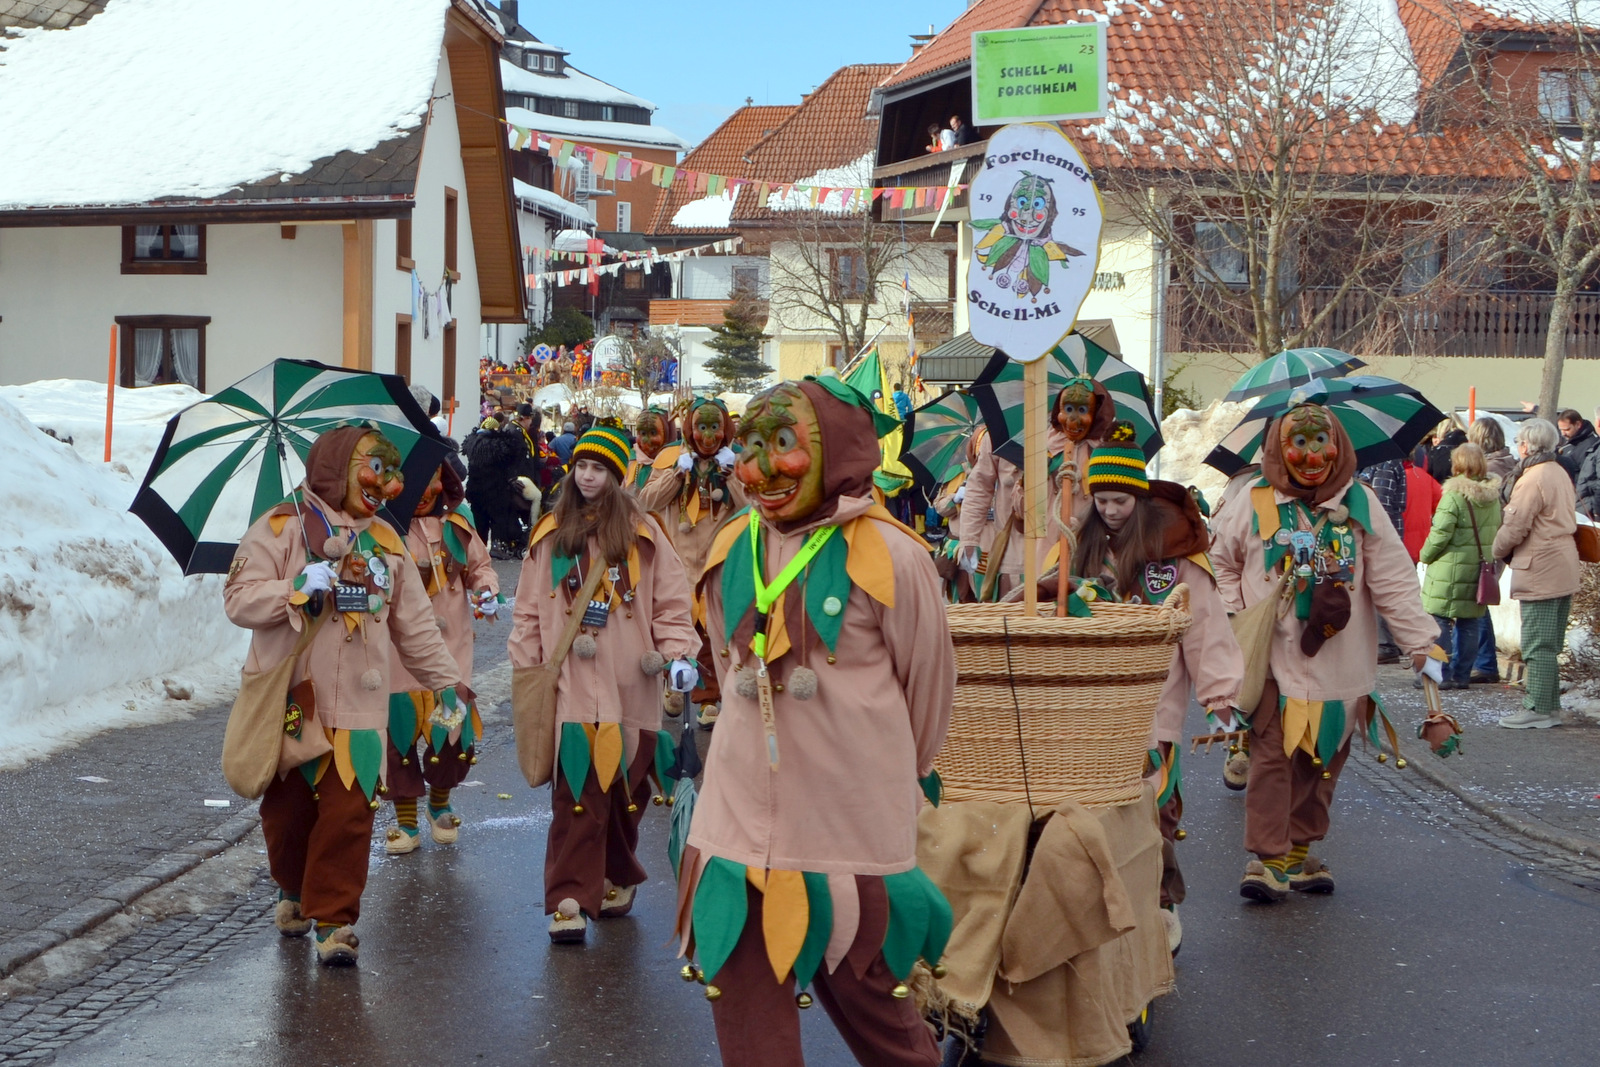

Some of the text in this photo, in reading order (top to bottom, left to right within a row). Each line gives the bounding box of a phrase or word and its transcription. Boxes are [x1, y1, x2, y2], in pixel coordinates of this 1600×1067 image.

[1078, 44, 1095, 55] 23
[1000, 63, 1074, 79] SCHELL-MI
[997, 81, 1077, 98] FORCHHEIM
[985, 148, 1095, 183] Forchemer
[978, 193, 1087, 217] 19 95
[967, 289, 1062, 321] Schell-Mi
